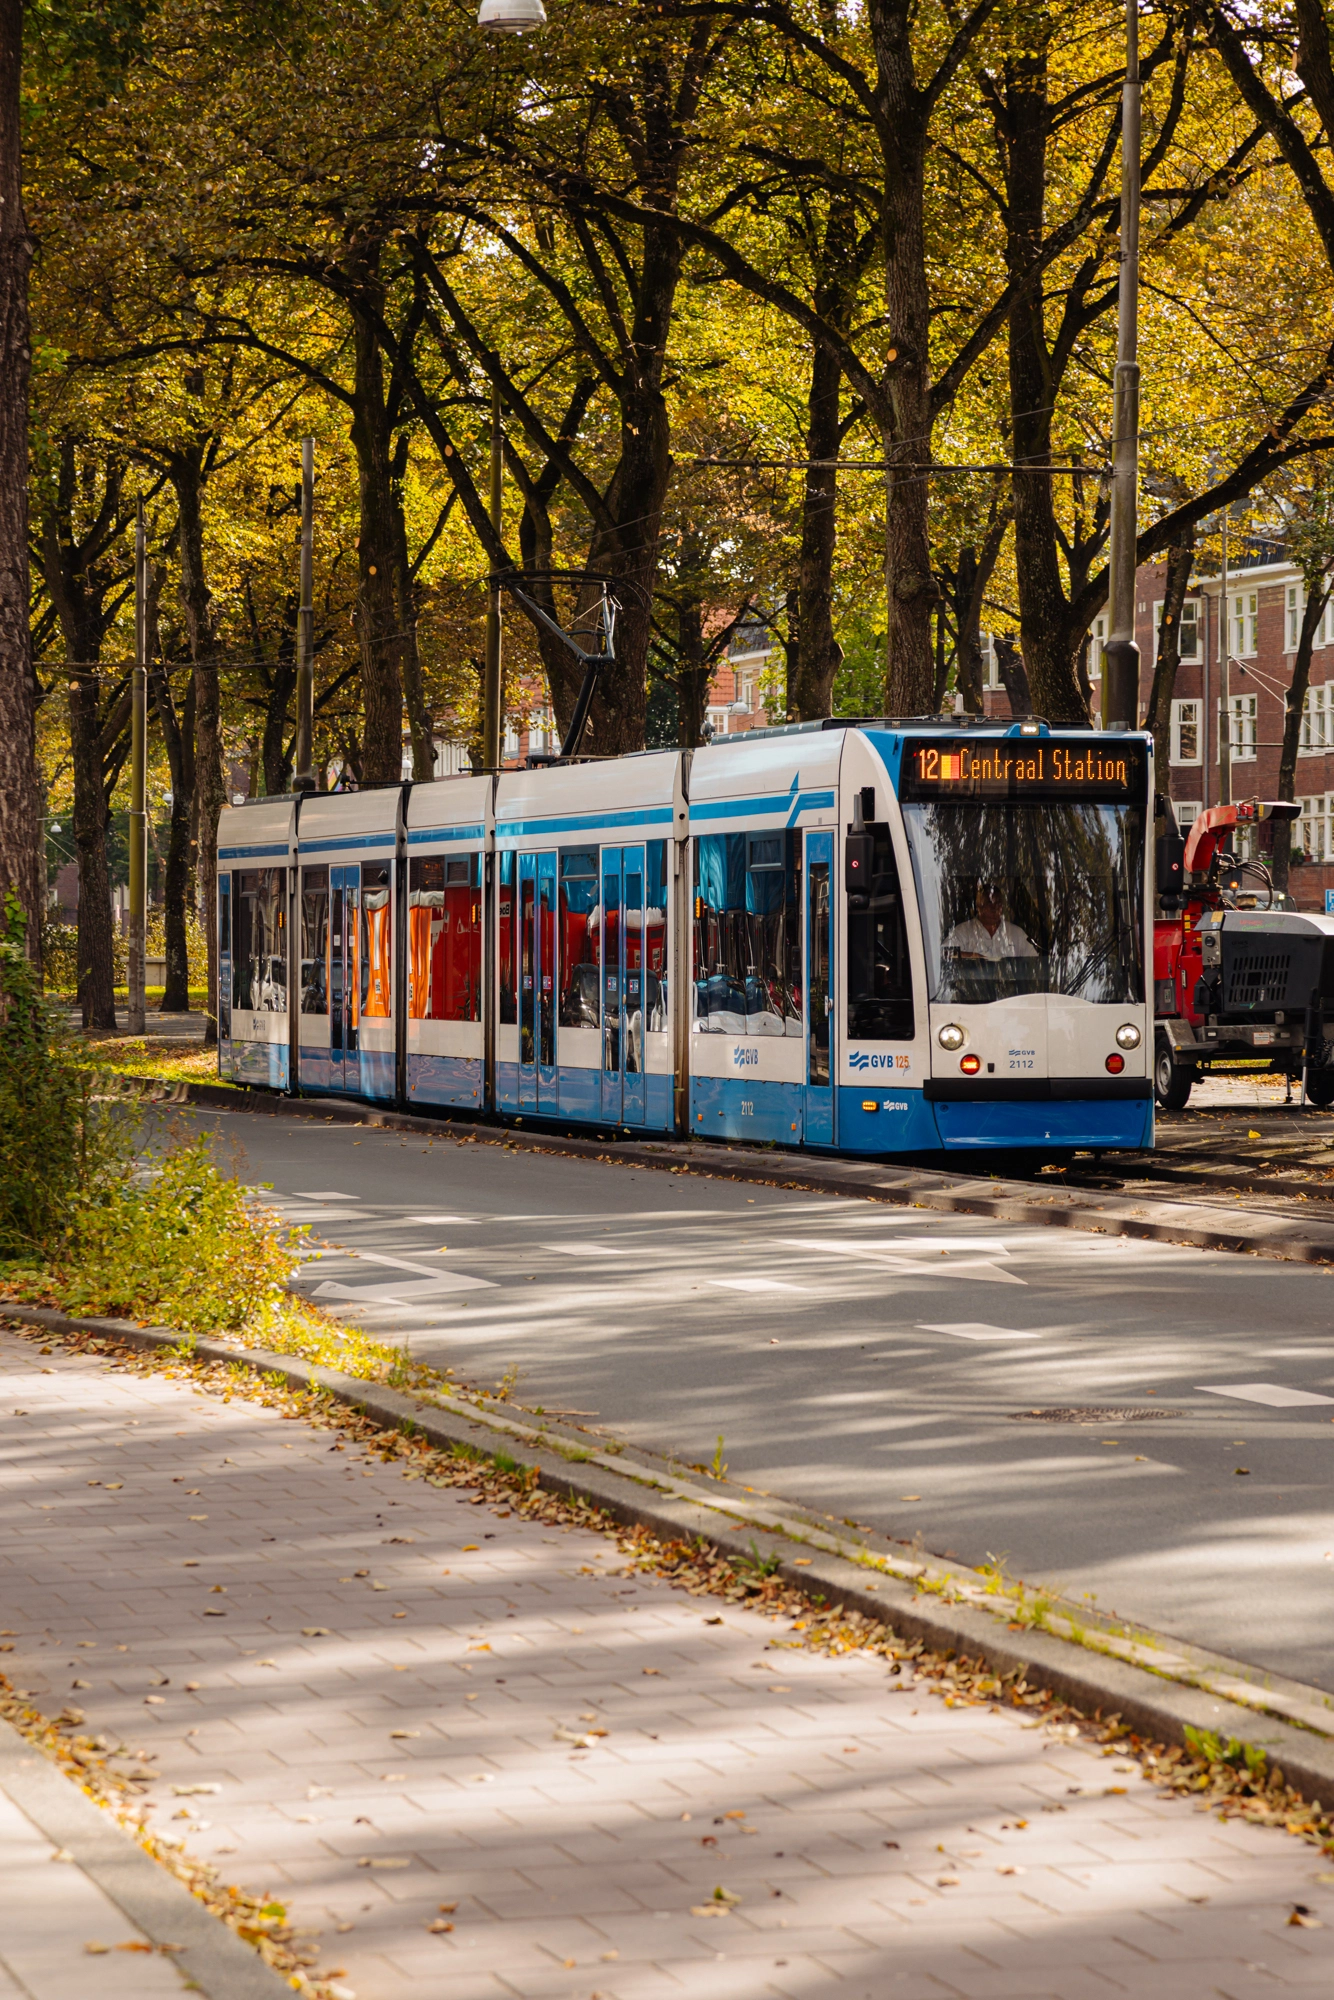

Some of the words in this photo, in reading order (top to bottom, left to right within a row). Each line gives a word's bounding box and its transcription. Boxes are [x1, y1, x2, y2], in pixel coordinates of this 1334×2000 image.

[919, 749, 938, 779] 12
[960, 748, 1044, 780] Centraal
[1052, 749, 1126, 780] Station
[745, 1048, 759, 1065] GVB
[871, 1054, 894, 1068] GVB
[895, 1055, 910, 1069] 125
[1009, 1060, 1034, 1069] 2112
[741, 1100, 754, 1116] 2112
[895, 1102, 908, 1111] GVB
